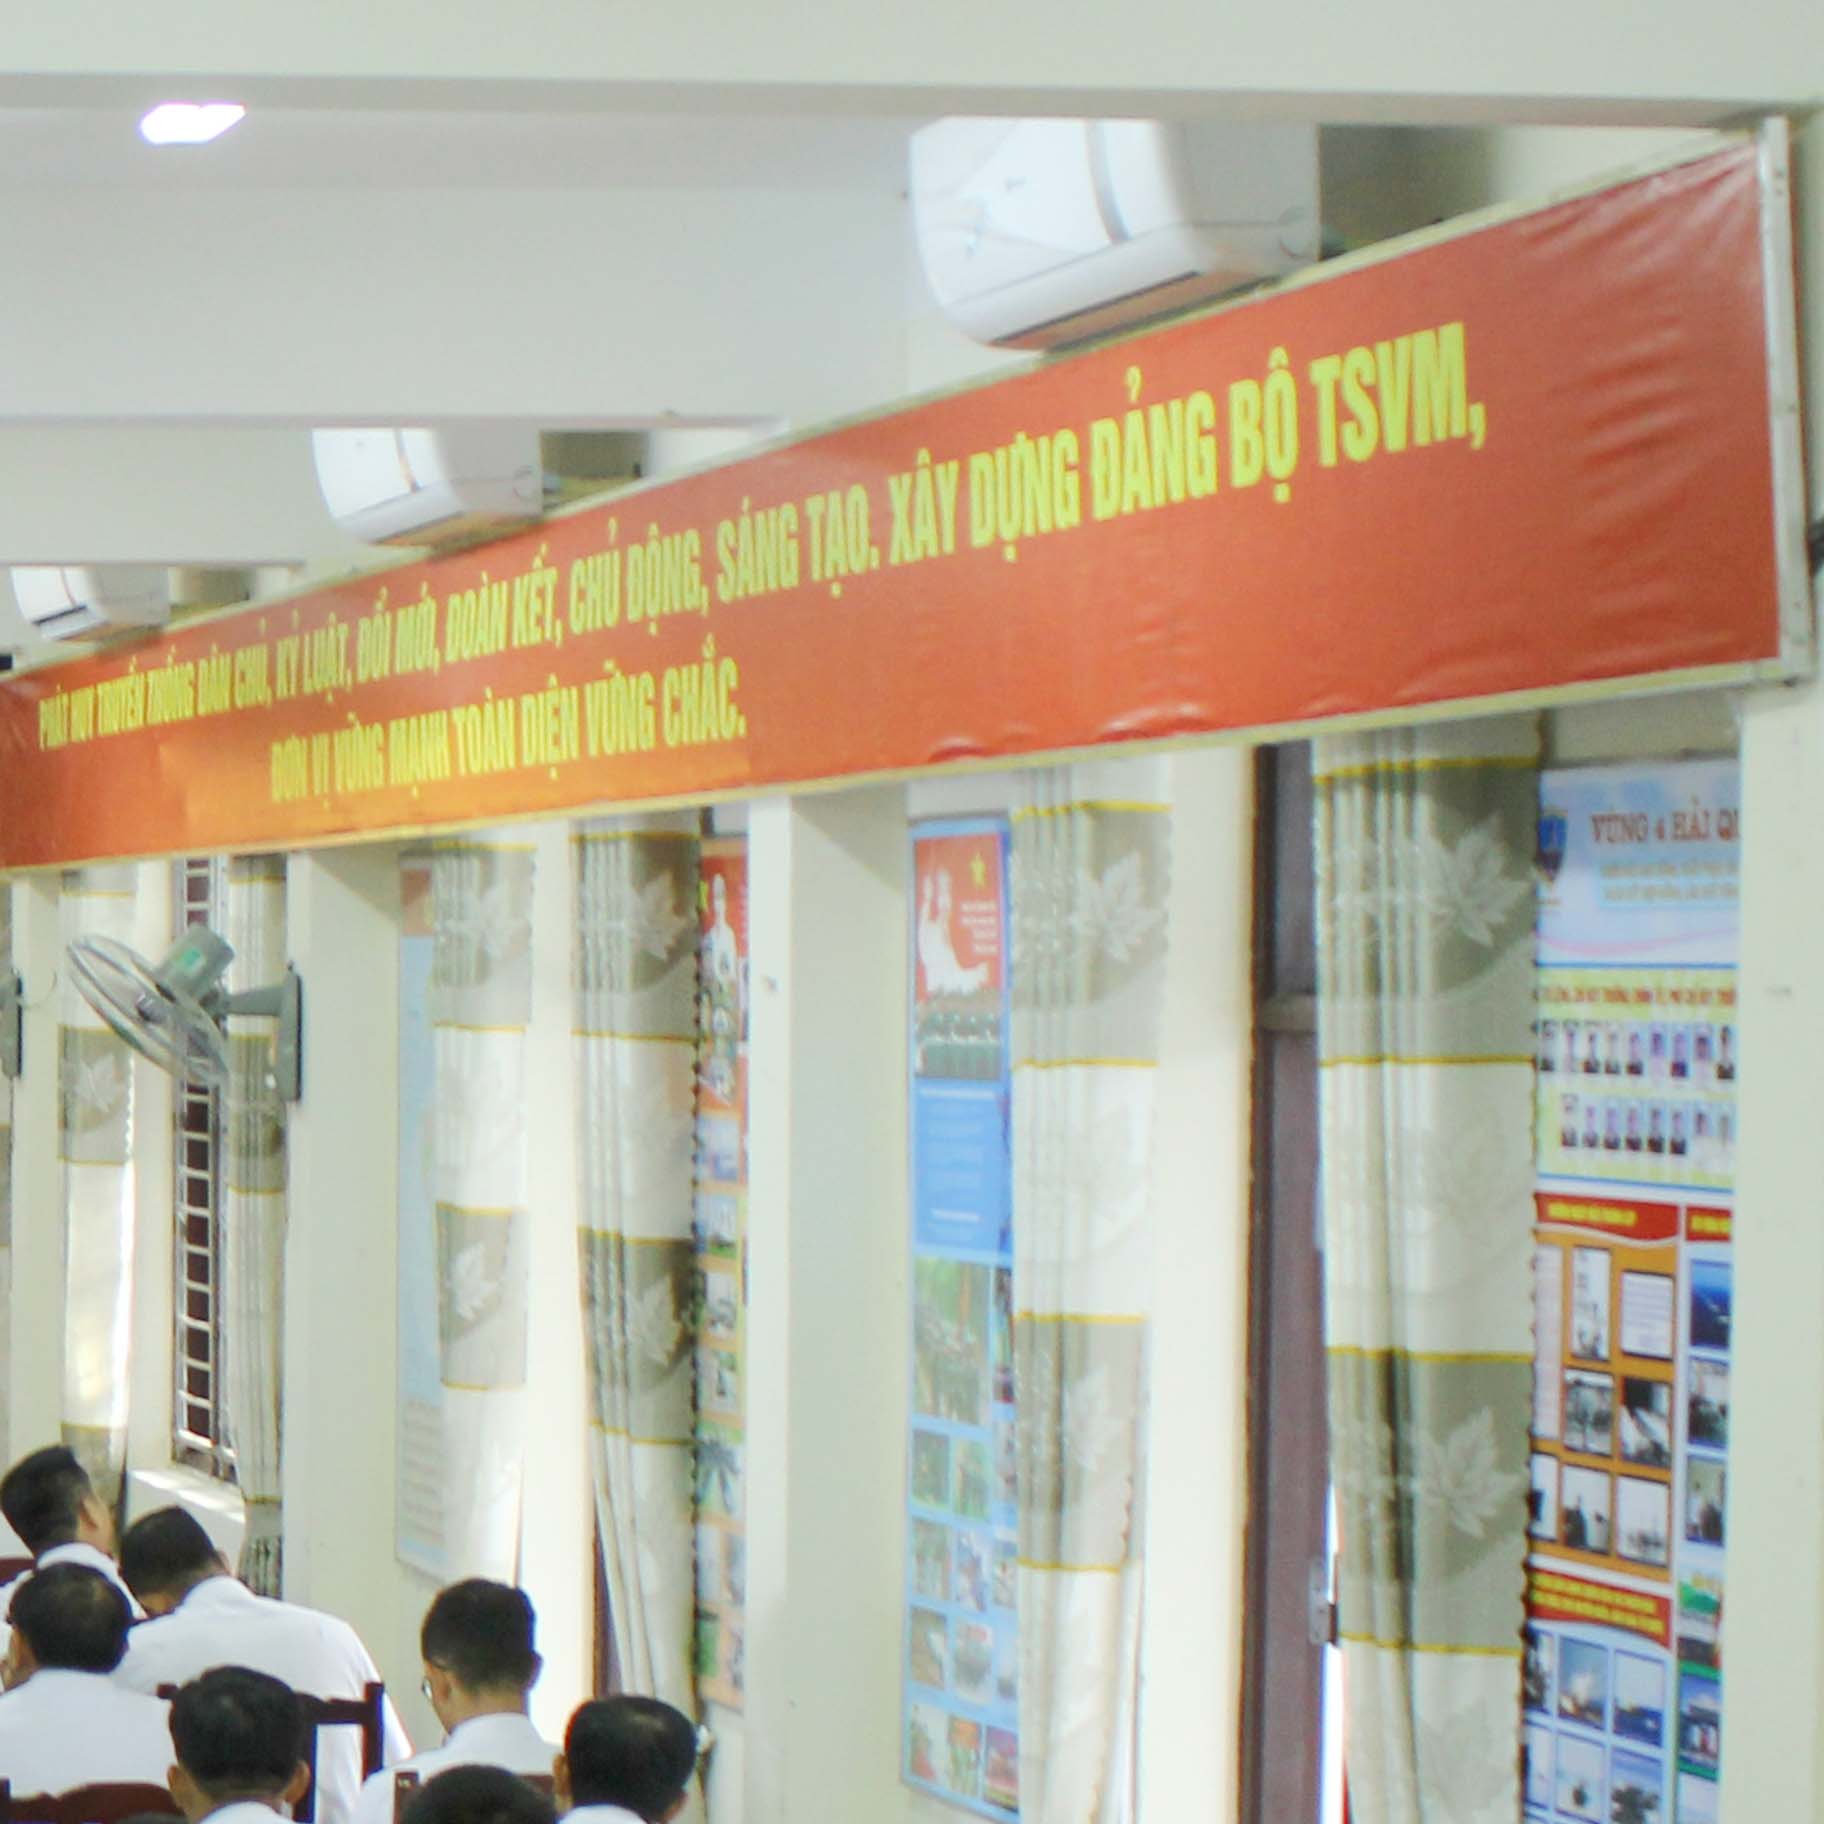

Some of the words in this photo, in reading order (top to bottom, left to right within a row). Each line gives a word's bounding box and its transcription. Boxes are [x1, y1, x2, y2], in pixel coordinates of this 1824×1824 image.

[303, 612, 351, 703] LUẬT,
[357, 586, 392, 684] ĐỔI
[395, 582, 439, 675] MỚI,
[445, 571, 509, 663] ĐOÀN
[512, 543, 563, 648] KẾT,
[569, 517, 620, 635] CHỦ
[627, 523, 709, 635] ĐỘNG,
[716, 496, 799, 604] SÁNG
[888, 448, 959, 566] XÂY
[969, 430, 1080, 562] DỰNG
[1090, 366, 1217, 520] ĐẢNG
[1229, 347, 1301, 504] BỘ
[1311, 320, 1486, 468] TSVM,
[388, 710, 450, 798] MẠNH
[452, 687, 515, 776] TOÀN
[521, 673, 579, 780] DIỆN
[584, 659, 656, 758] VỮNG
[662, 633, 746, 747] CHẮC.
